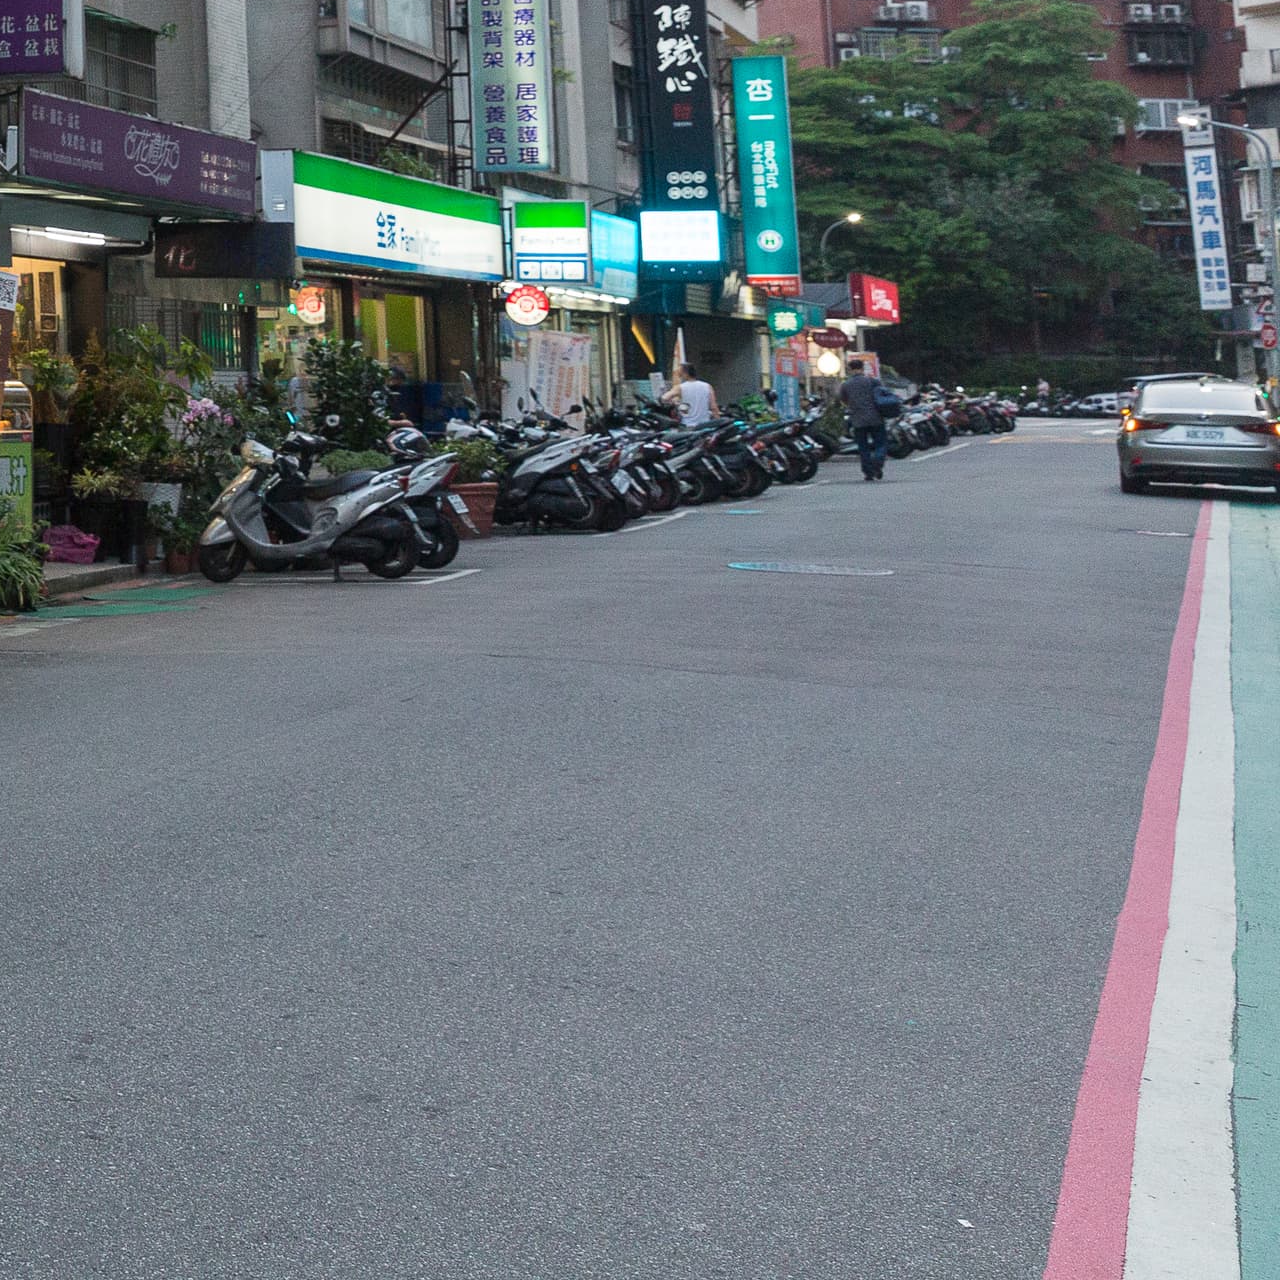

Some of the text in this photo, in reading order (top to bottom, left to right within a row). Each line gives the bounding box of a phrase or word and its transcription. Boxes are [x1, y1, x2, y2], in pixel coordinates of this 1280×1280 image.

[514, 82, 541, 166] 居家護理
[746, 77, 775, 121] 杏一
